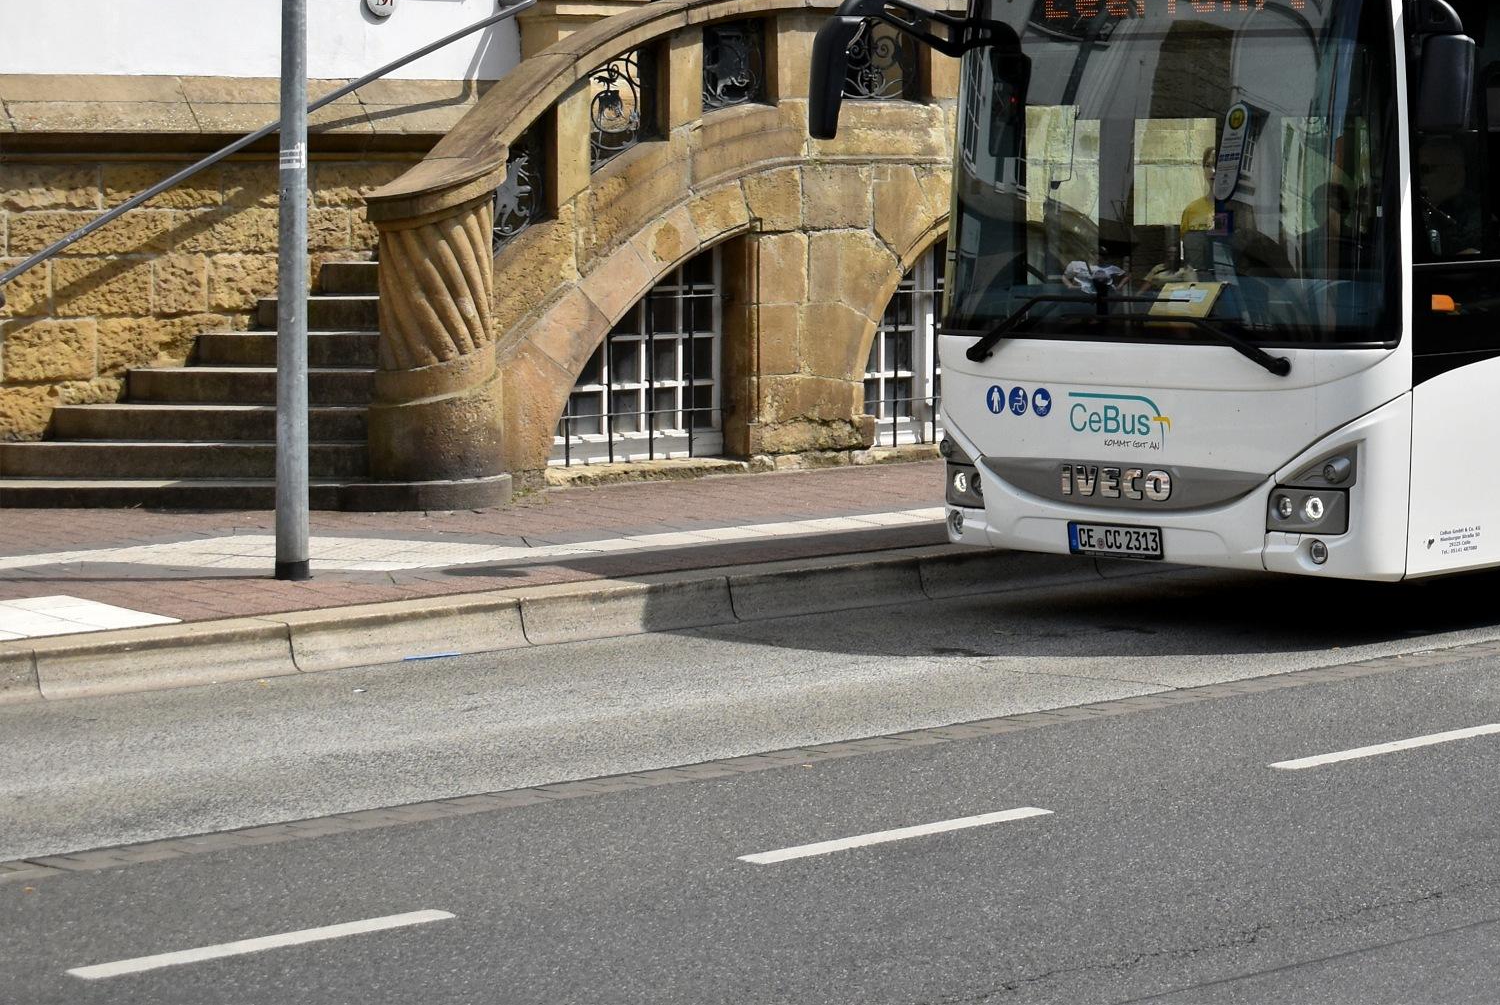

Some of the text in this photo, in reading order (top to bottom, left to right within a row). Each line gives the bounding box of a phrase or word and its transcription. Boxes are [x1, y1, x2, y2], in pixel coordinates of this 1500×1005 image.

[1070, 403, 1150, 436] CeBus
[1104, 439, 1131, 447] KOMMT
[1149, 441, 1160, 450] AN
[1062, 464, 1172, 502] IVECO
[1078, 527, 1159, 552] CE CC 2313
